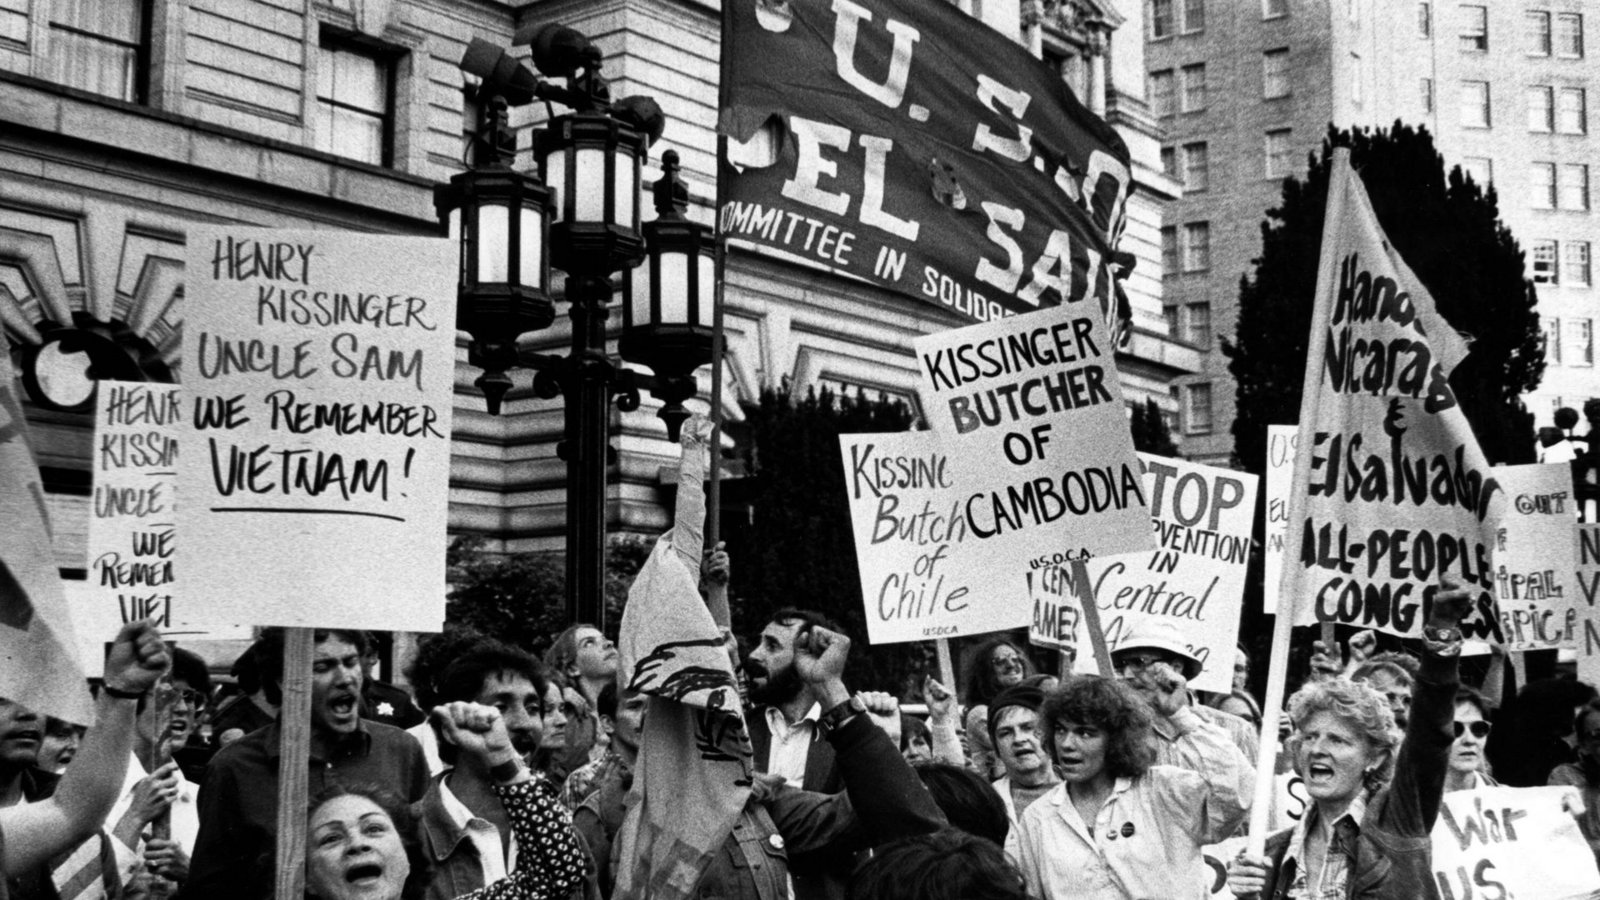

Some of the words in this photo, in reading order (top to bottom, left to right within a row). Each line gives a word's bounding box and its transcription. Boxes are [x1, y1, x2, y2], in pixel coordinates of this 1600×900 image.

[782, 115, 920, 242] EL
[211, 235, 314, 285] HENRY
[874, 245, 907, 282] IN
[922, 265, 1018, 322] SOLIDA
[258, 286, 437, 331] KISSINGER
[199, 332, 318, 380] UNCLE
[331, 333, 424, 391] SAM
[924, 317, 1101, 392] KISSINGER
[194, 394, 251, 430] WE
[264, 390, 446, 440] REMEMBER
[948, 364, 1114, 435] BUTCHER
[1003, 423, 1052, 466] OF
[1308, 432, 1342, 498] El
[96, 483, 164, 519] UNCLE
[966, 462, 1146, 539] CAMBODIA
[1139, 457, 1245, 531] TOP
[133, 529, 176, 559] WE
[913, 544, 949, 579] of
[1147, 551, 1180, 574] IN
[878, 573, 969, 621] Chile
[1094, 562, 1220, 622] Central
